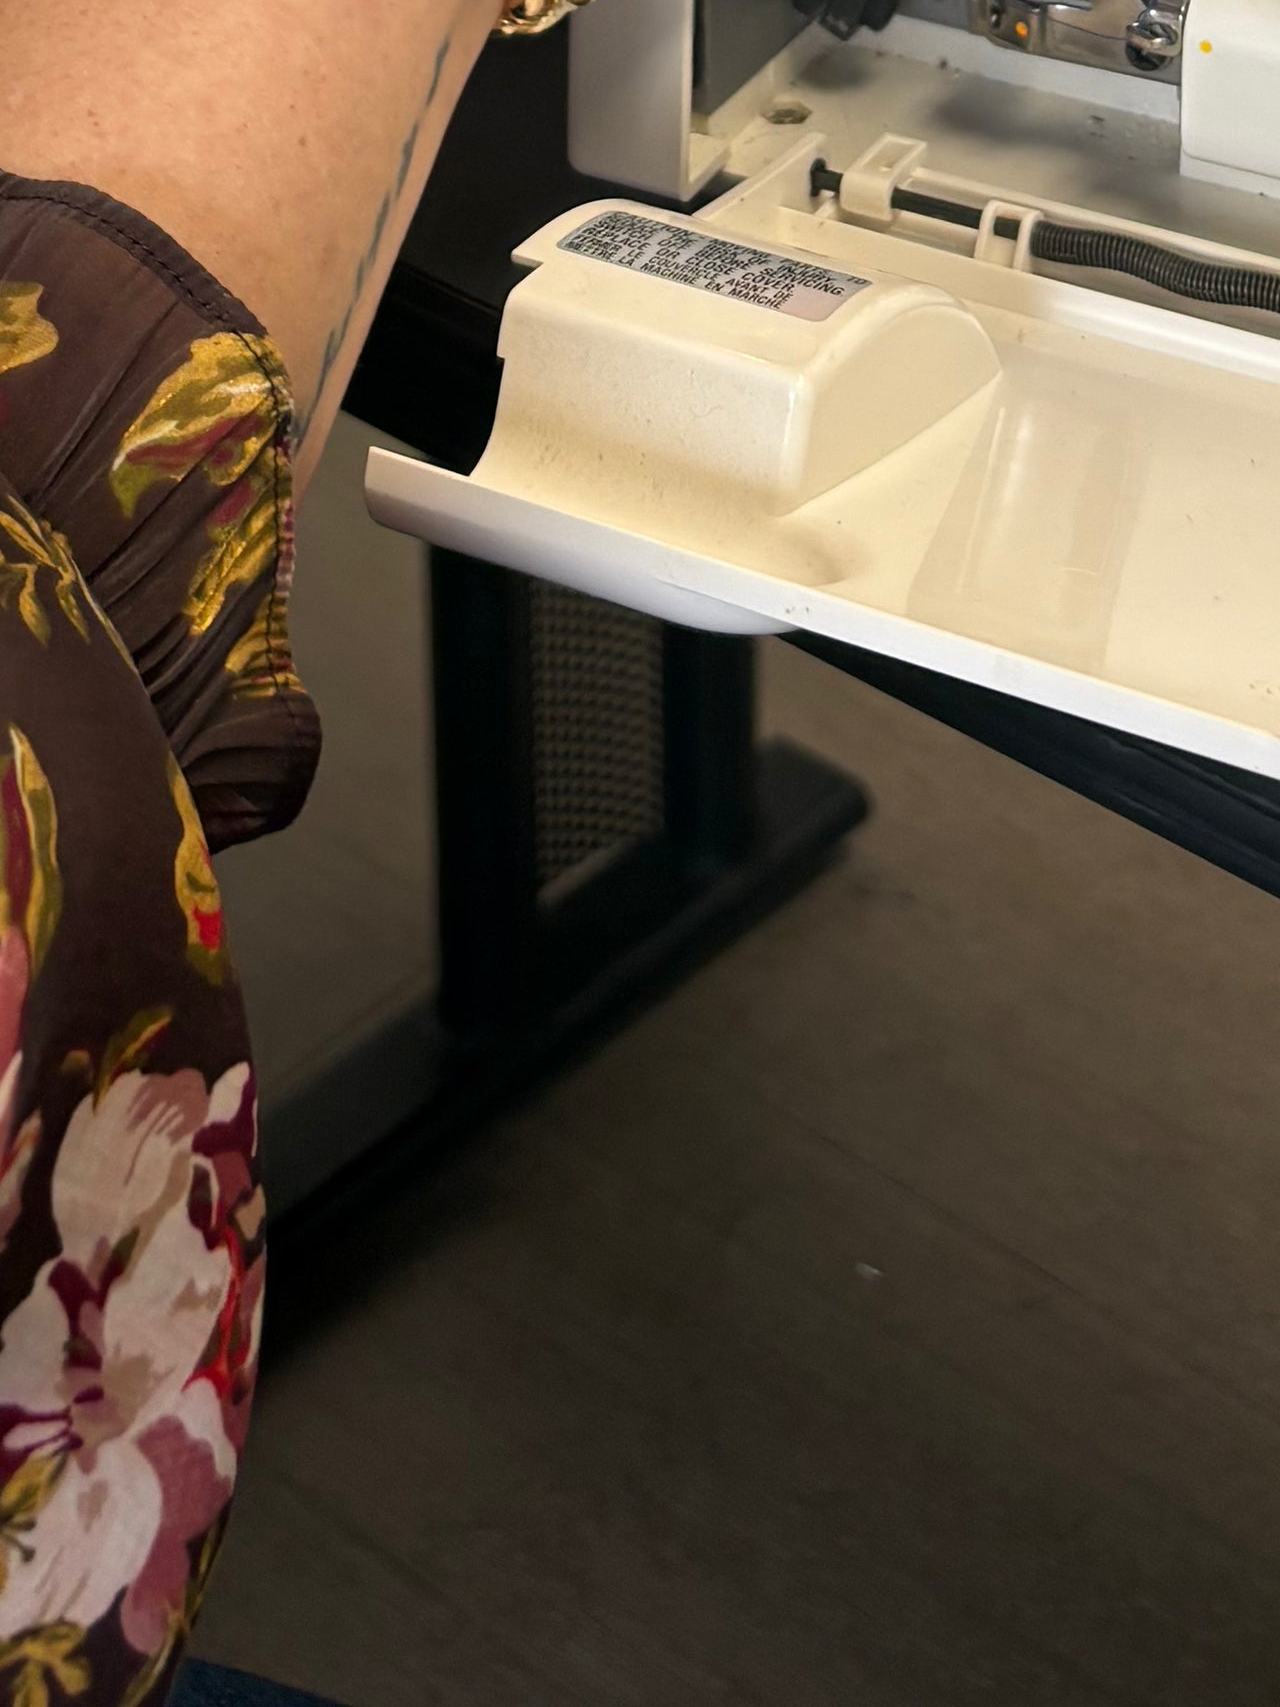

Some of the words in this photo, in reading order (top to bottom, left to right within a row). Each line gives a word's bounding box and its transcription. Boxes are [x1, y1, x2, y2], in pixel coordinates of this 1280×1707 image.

[581, 226, 652, 250] REPLACE
[655, 247, 682, 259] OR
[683, 256, 738, 275] CLOSE
[626, 249, 647, 258] LE
[647, 255, 722, 280] COUVERCLE
[723, 277, 770, 294] AVANT
[772, 291, 795, 301] DE
[615, 255, 638, 266] LA
[637, 262, 701, 284] MACHINE
[702, 280, 726, 291] EN
[726, 287, 787, 309] MARCHE
